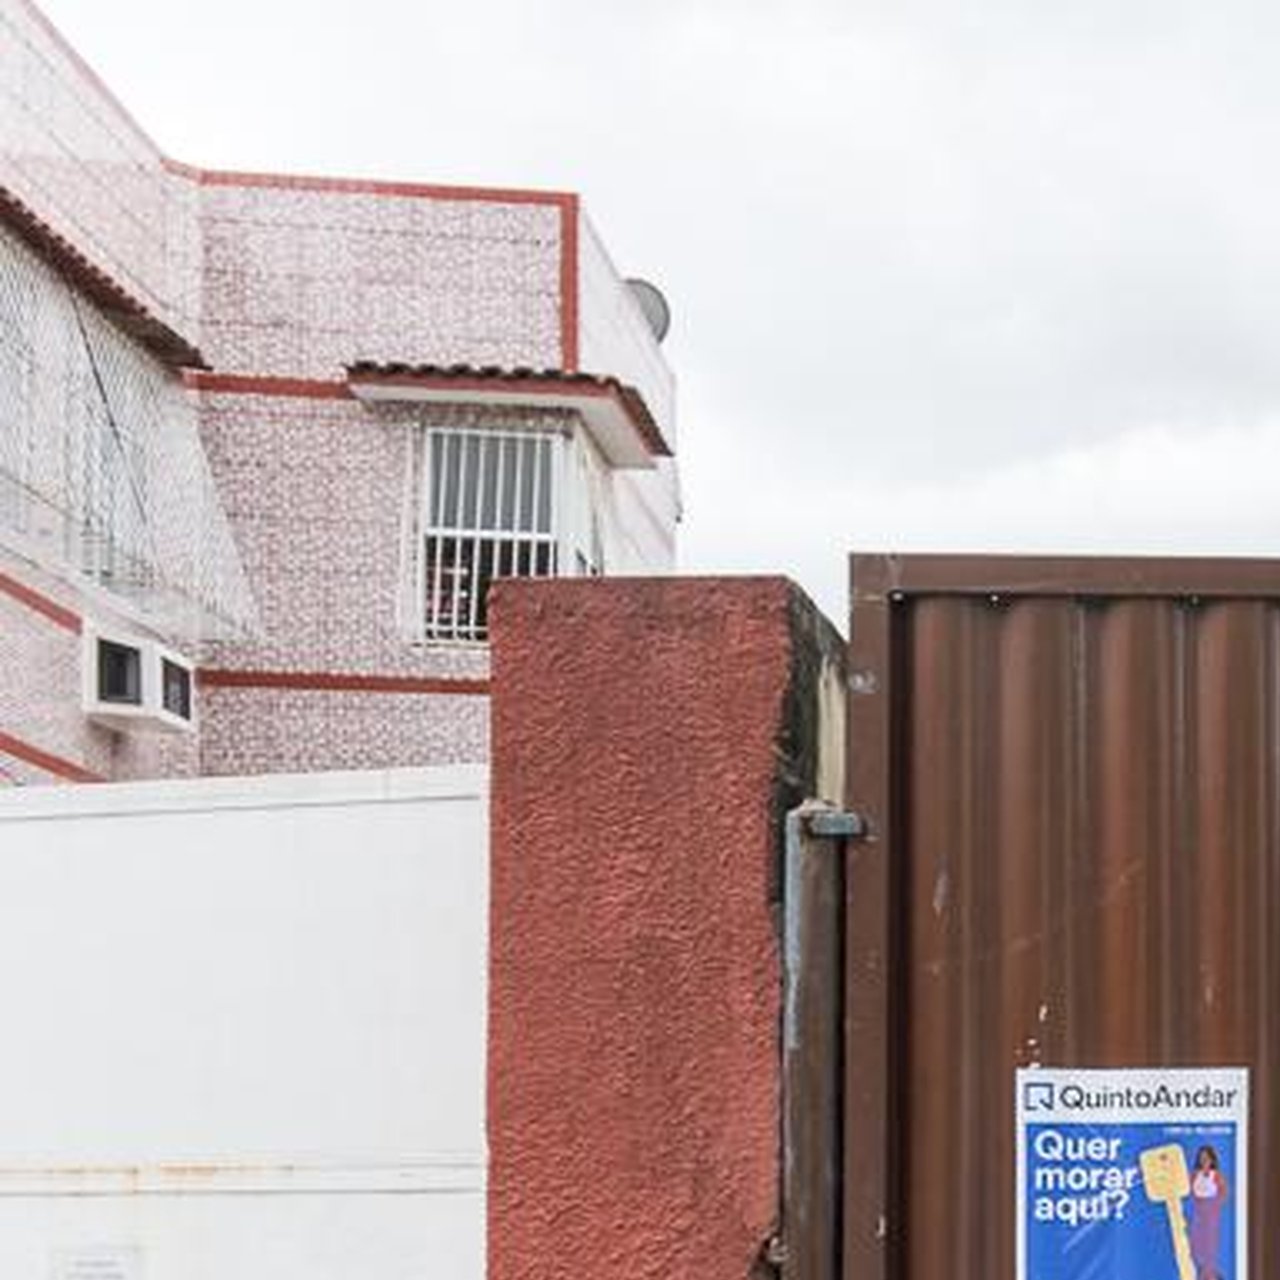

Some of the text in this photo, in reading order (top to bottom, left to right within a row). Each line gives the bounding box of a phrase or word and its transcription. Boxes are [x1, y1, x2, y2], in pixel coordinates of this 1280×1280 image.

[1060, 1085, 1237, 1111] QuintoAndar
[1034, 1131, 1121, 1161] Quer
[1035, 1168, 1138, 1190] morar
[1034, 1192, 1129, 1224] aqui?
